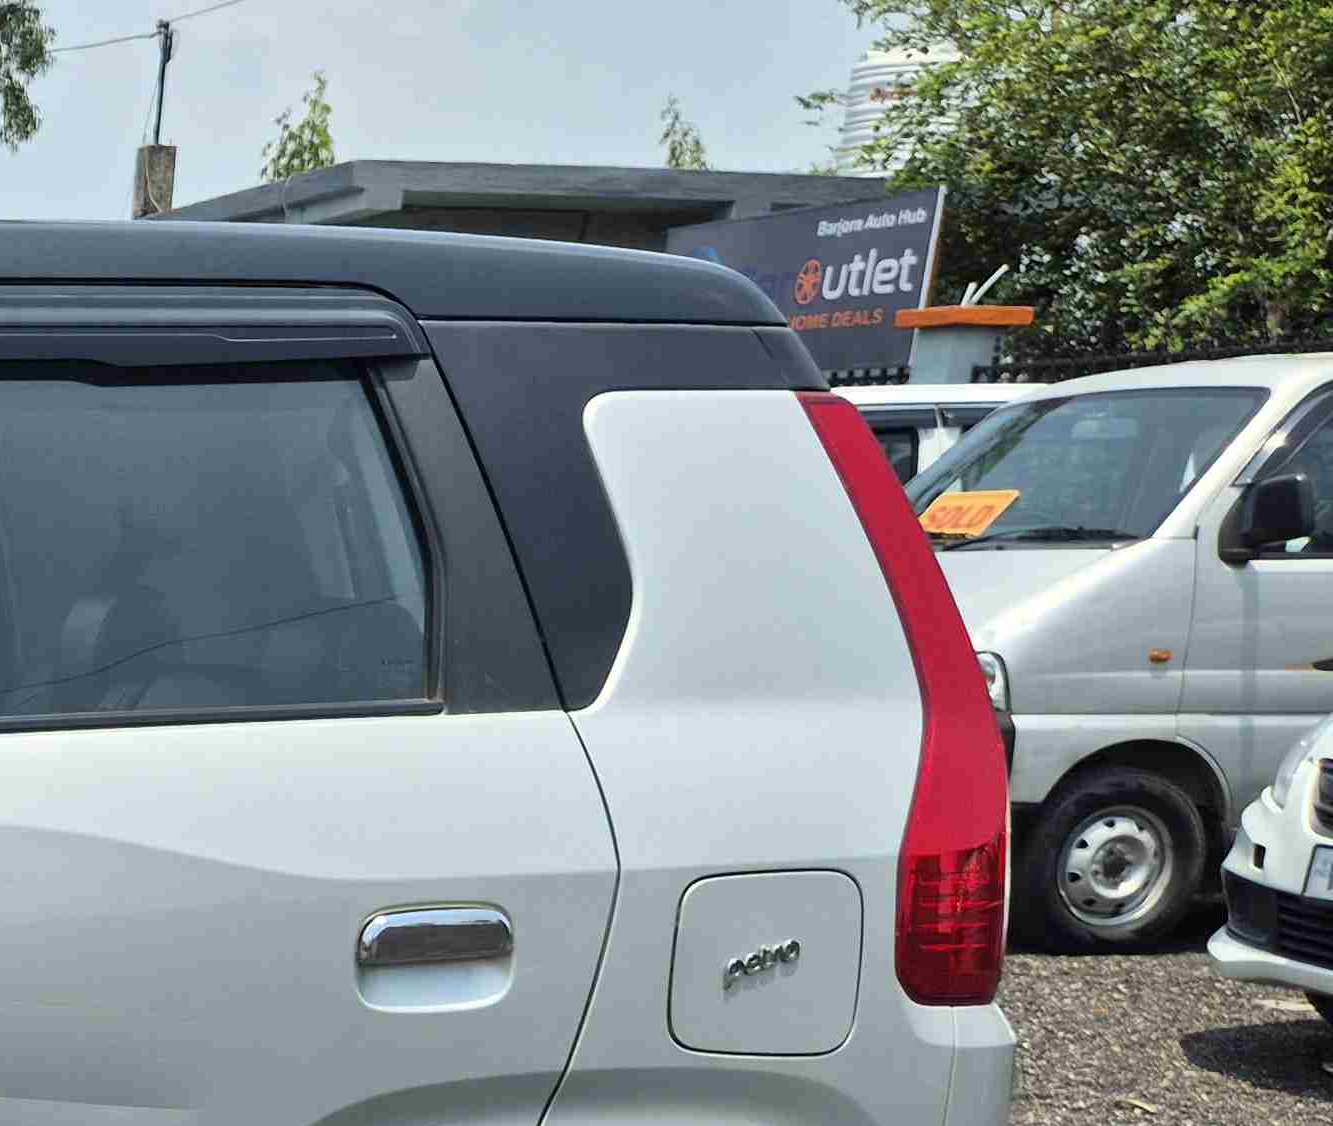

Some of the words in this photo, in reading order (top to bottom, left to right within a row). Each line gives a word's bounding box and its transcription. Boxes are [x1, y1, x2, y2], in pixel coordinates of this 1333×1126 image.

[864, 212, 896, 229] Auto
[898, 207, 927, 225] Hub
[832, 308, 884, 327] DEALS
[927, 505, 996, 530] SOLD
